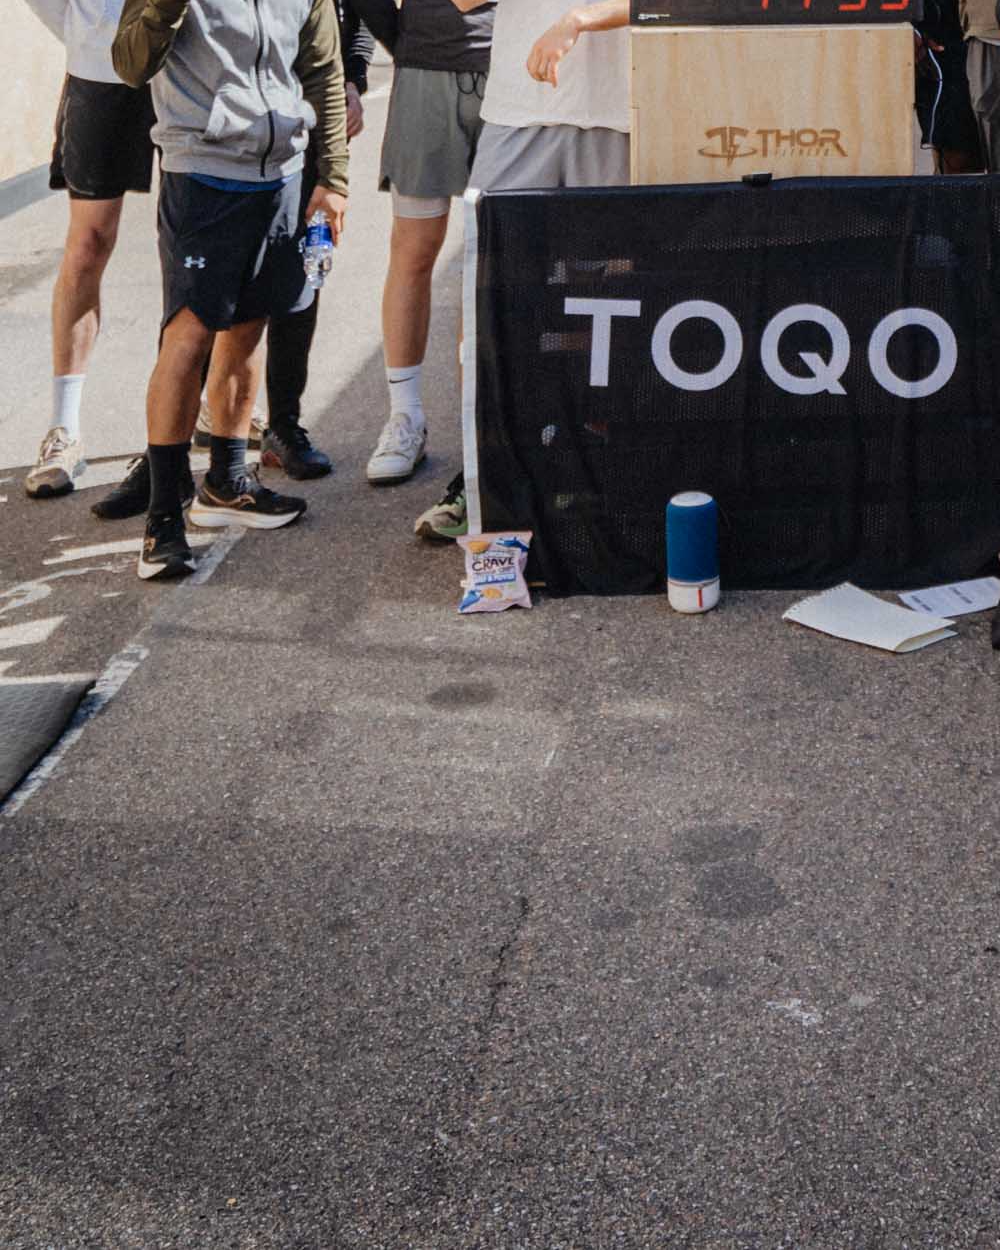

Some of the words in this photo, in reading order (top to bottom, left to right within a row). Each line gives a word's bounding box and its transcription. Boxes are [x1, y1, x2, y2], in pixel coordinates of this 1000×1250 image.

[756, 129, 849, 158] THOR
[564, 297, 958, 399] TOQO
[472, 557, 515, 571] CRAVE
